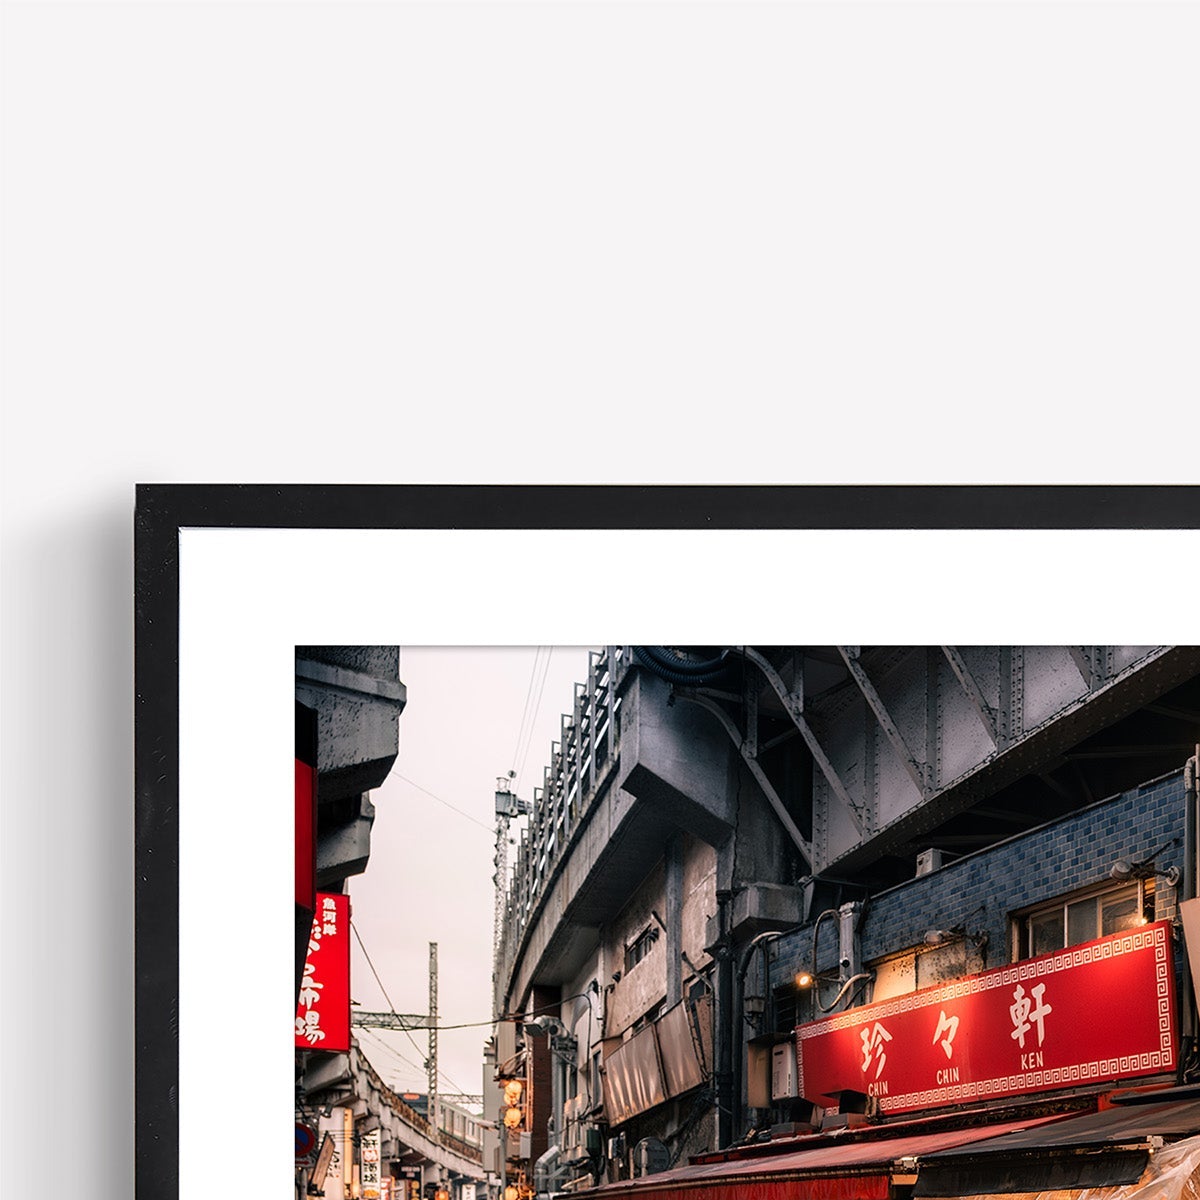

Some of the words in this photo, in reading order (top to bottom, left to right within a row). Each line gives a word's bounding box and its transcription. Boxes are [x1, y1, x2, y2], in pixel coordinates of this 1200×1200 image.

[322, 897, 337, 936] 魚河岸
[868, 1081, 889, 1097] CHIN
[936, 1067, 960, 1085] CHIN
[1020, 1050, 1044, 1070] KEN
